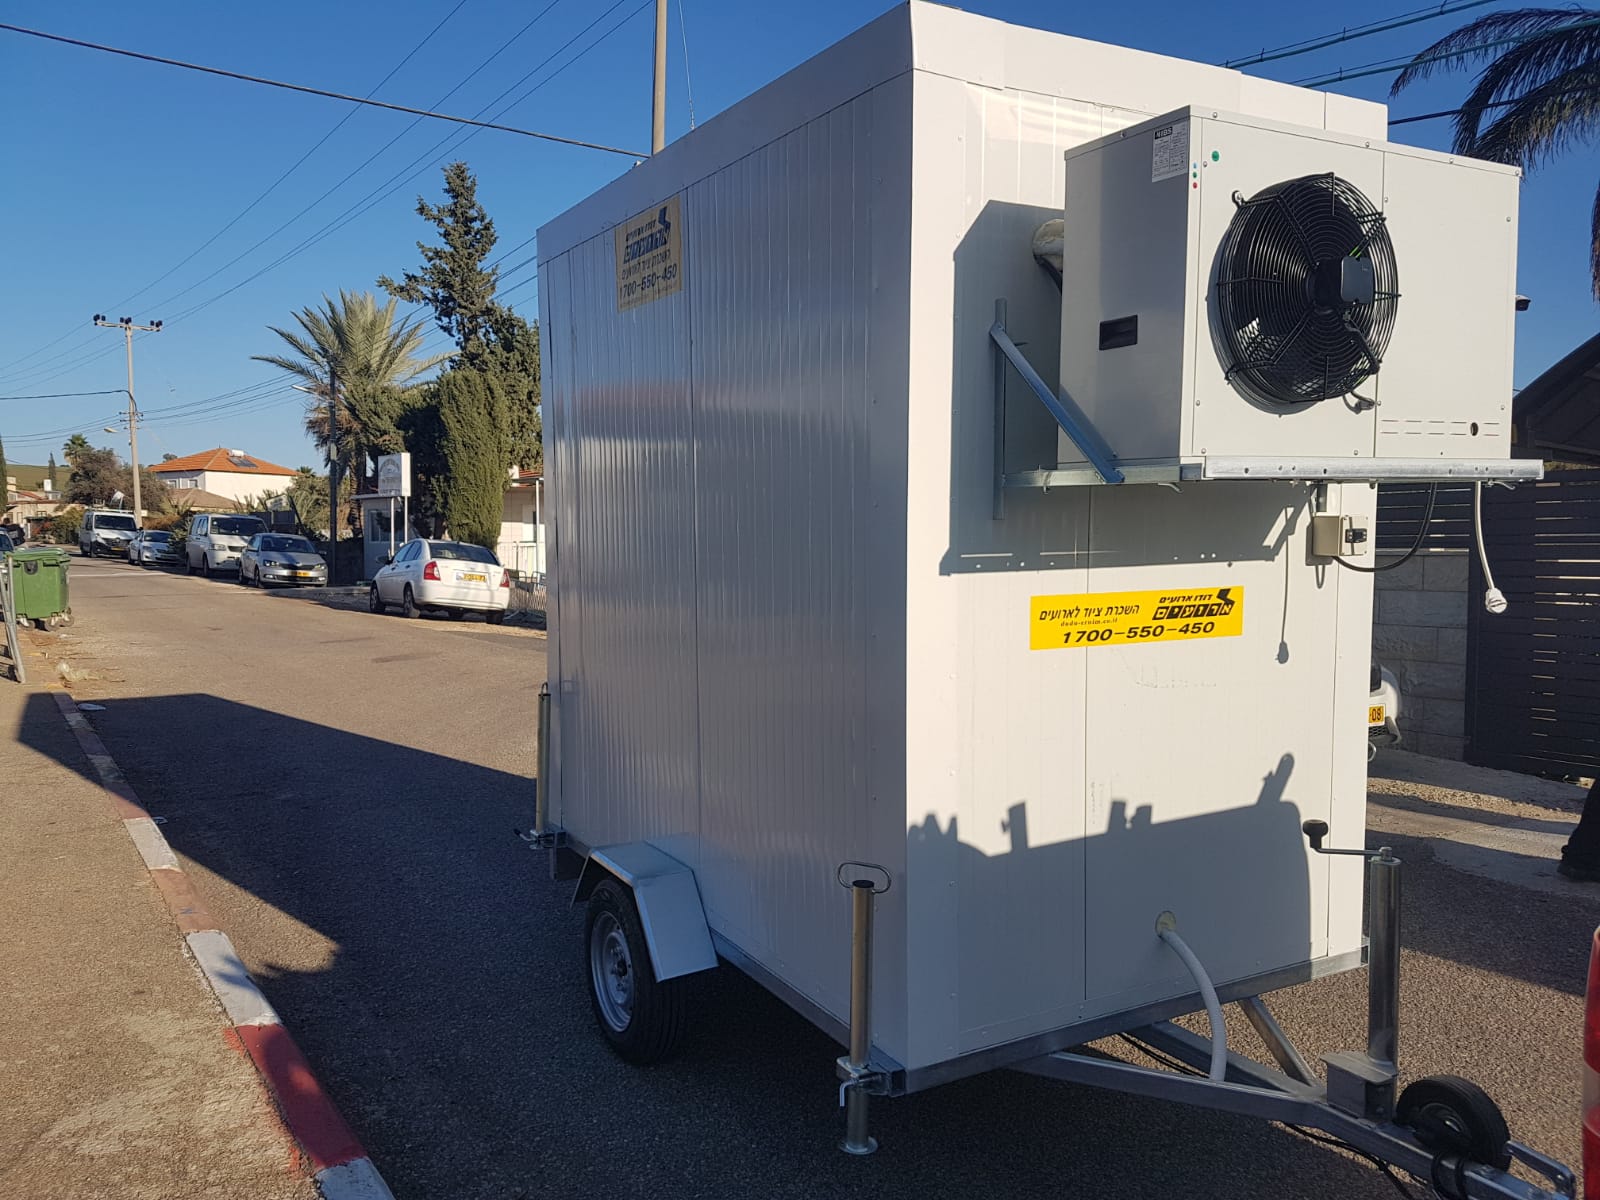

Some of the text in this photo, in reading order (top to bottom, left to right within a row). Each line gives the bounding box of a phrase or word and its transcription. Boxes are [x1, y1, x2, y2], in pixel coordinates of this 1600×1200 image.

[1159, 594, 1214, 603] דודו ארועים
[1039, 604, 1140, 621] השכרת ציוד לארועים
[1153, 602, 1235, 620] ארועים
[1063, 621, 1216, 643] 1700-550-450
